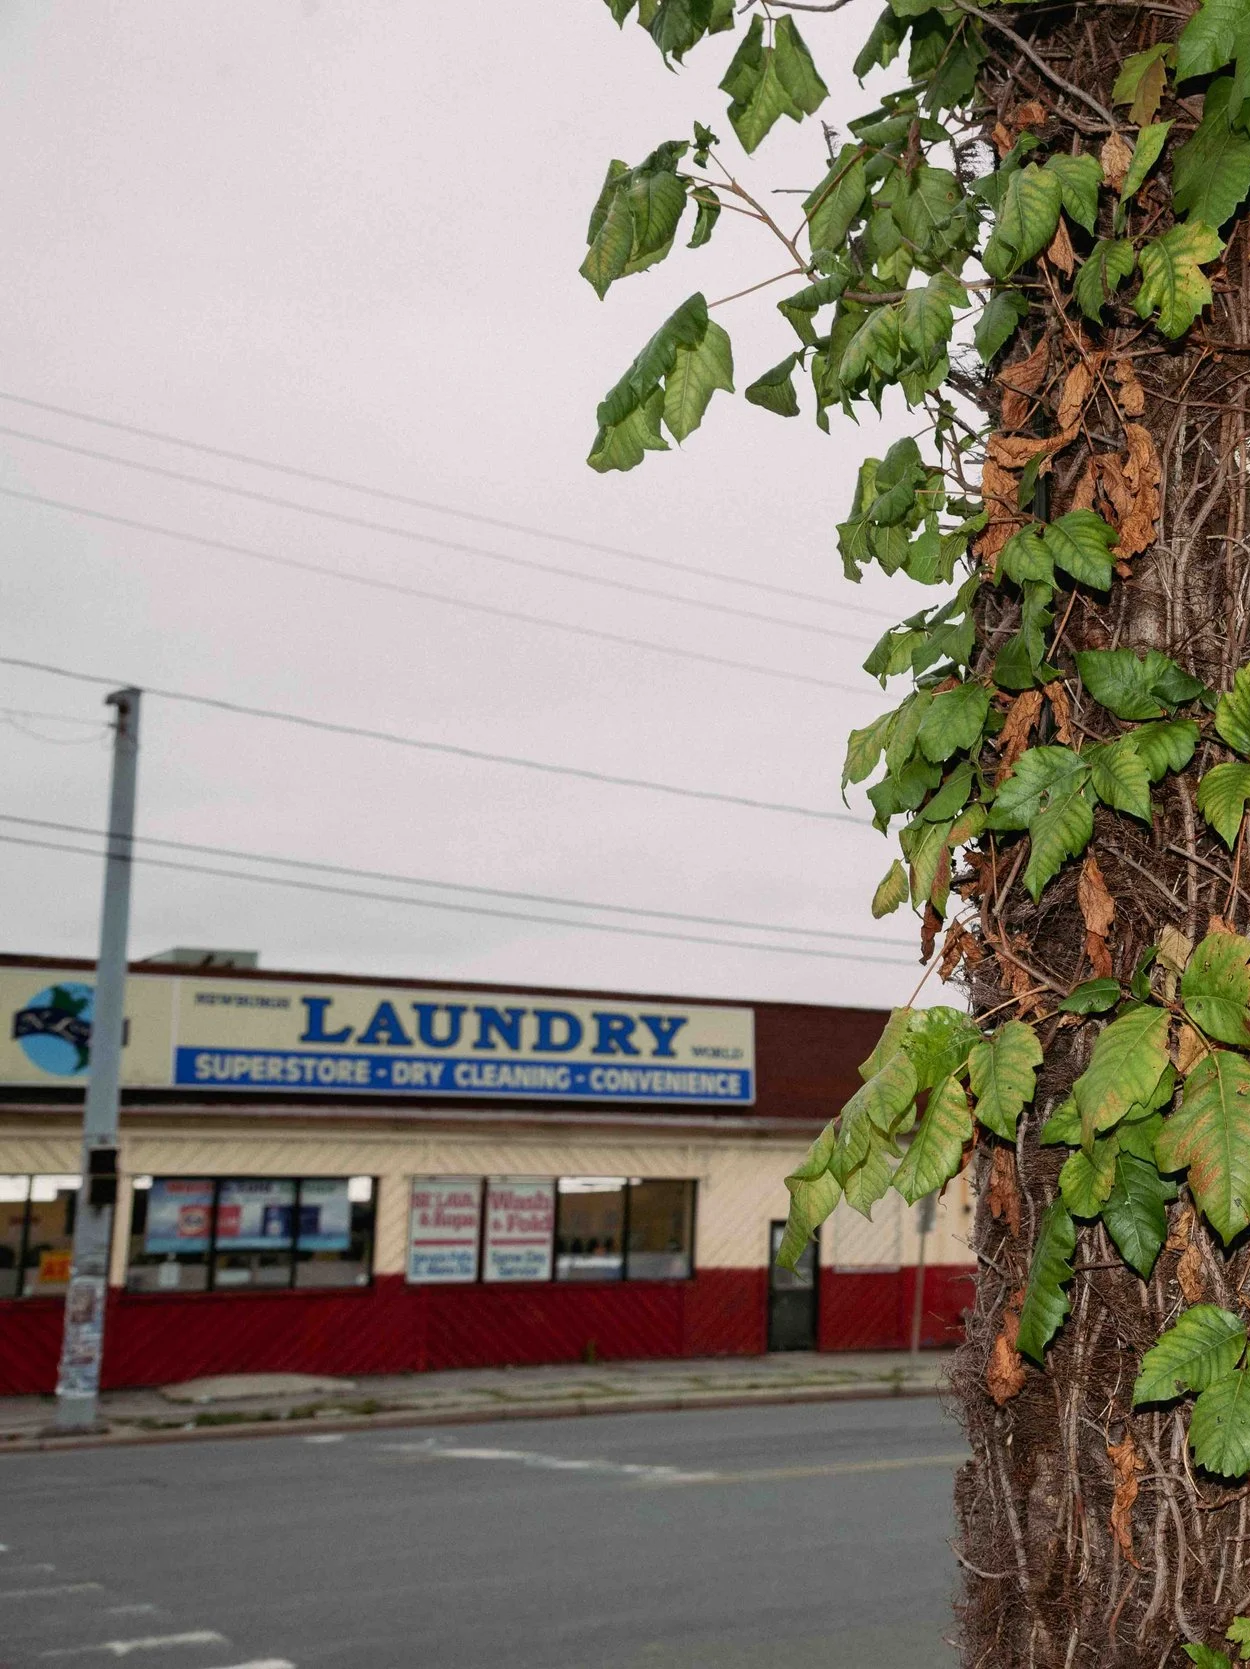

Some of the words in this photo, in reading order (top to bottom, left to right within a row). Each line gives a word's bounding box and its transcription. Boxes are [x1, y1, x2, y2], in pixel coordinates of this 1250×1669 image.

[301, 997, 688, 1058] LAUNDRY
[195, 1053, 371, 1084] SUPERSTORE
[392, 1060, 445, 1087] DRY
[454, 1062, 571, 1091] CLEANING
[590, 1067, 742, 1096] CONVENIENCE
